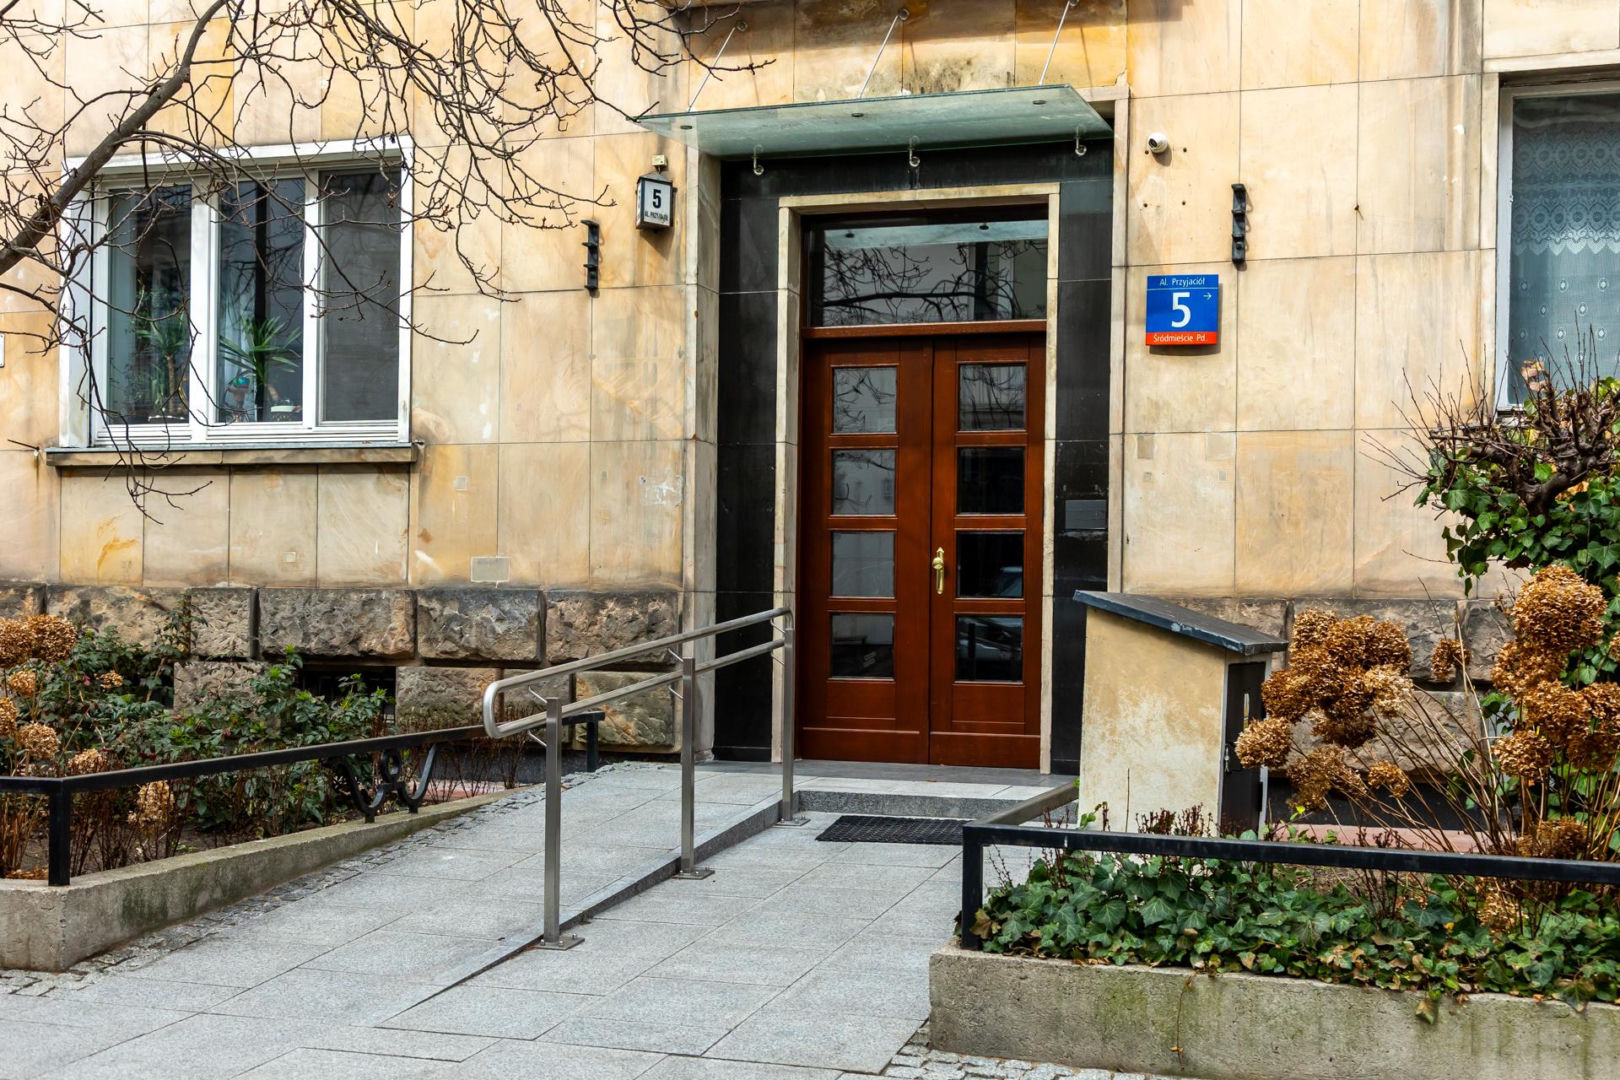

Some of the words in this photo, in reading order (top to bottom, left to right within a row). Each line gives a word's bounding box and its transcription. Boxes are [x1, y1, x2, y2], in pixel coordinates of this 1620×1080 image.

[652, 189, 662, 209] 5
[1160, 278, 1169, 286] Al.
[1171, 277, 1205, 288] Przyjaciół
[1171, 292, 1191, 328] 5
